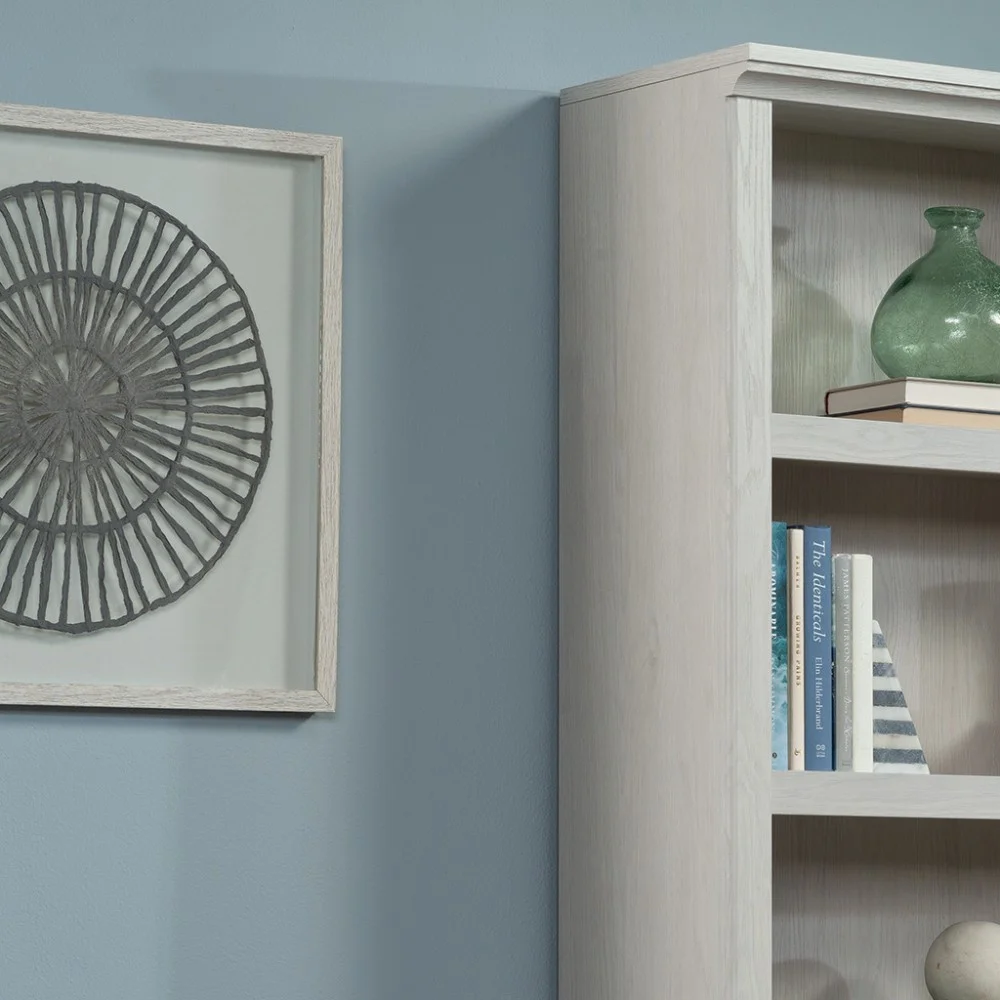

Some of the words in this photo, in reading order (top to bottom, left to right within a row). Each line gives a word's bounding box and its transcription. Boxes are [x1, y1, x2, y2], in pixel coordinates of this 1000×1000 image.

[812, 540, 826, 568] The
[842, 568, 850, 600] JAMES
[812, 572, 826, 643] Identicals
[843, 603, 851, 662] PATTERSON
[815, 657, 823, 675] Elin
[815, 678, 824, 730] Hilderbrand
